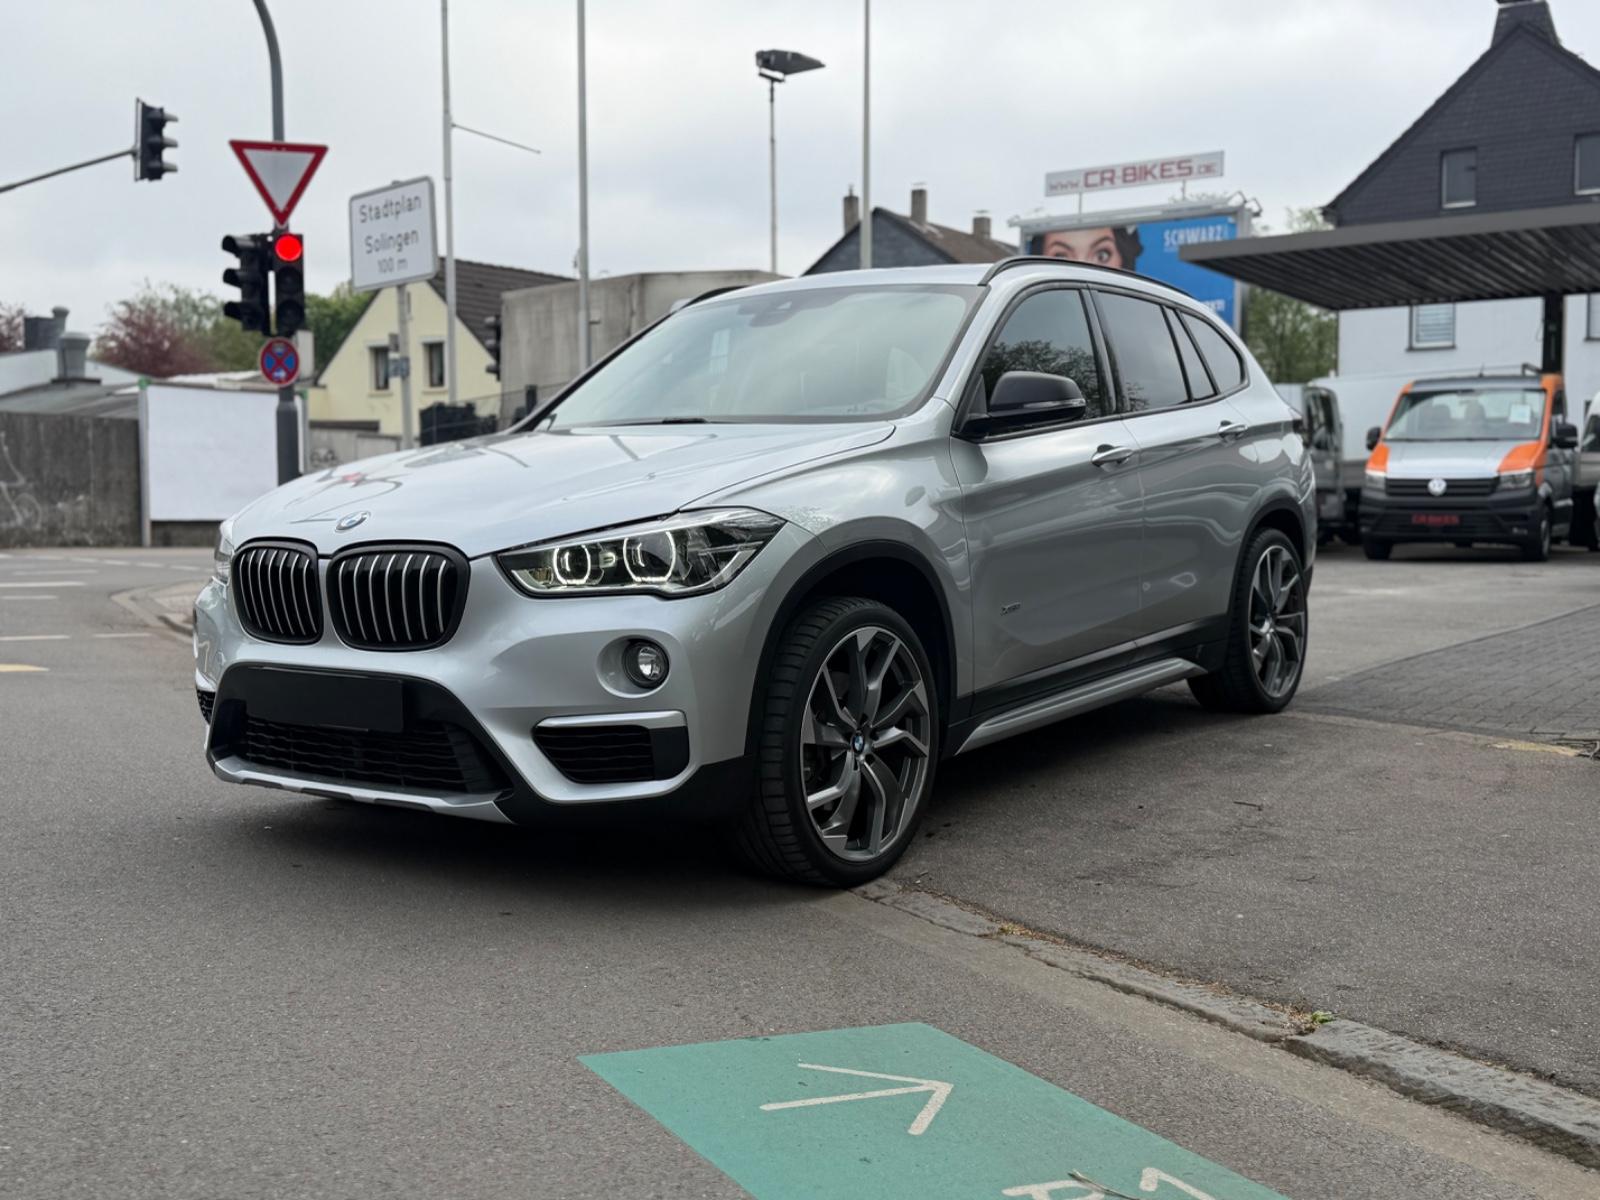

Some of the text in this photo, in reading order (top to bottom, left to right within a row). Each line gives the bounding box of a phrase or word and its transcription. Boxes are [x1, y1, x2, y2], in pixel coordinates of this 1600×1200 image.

[359, 195, 422, 223] Stadtplan
[364, 228, 419, 254] Solingen
[378, 257, 408, 273] 100 m
